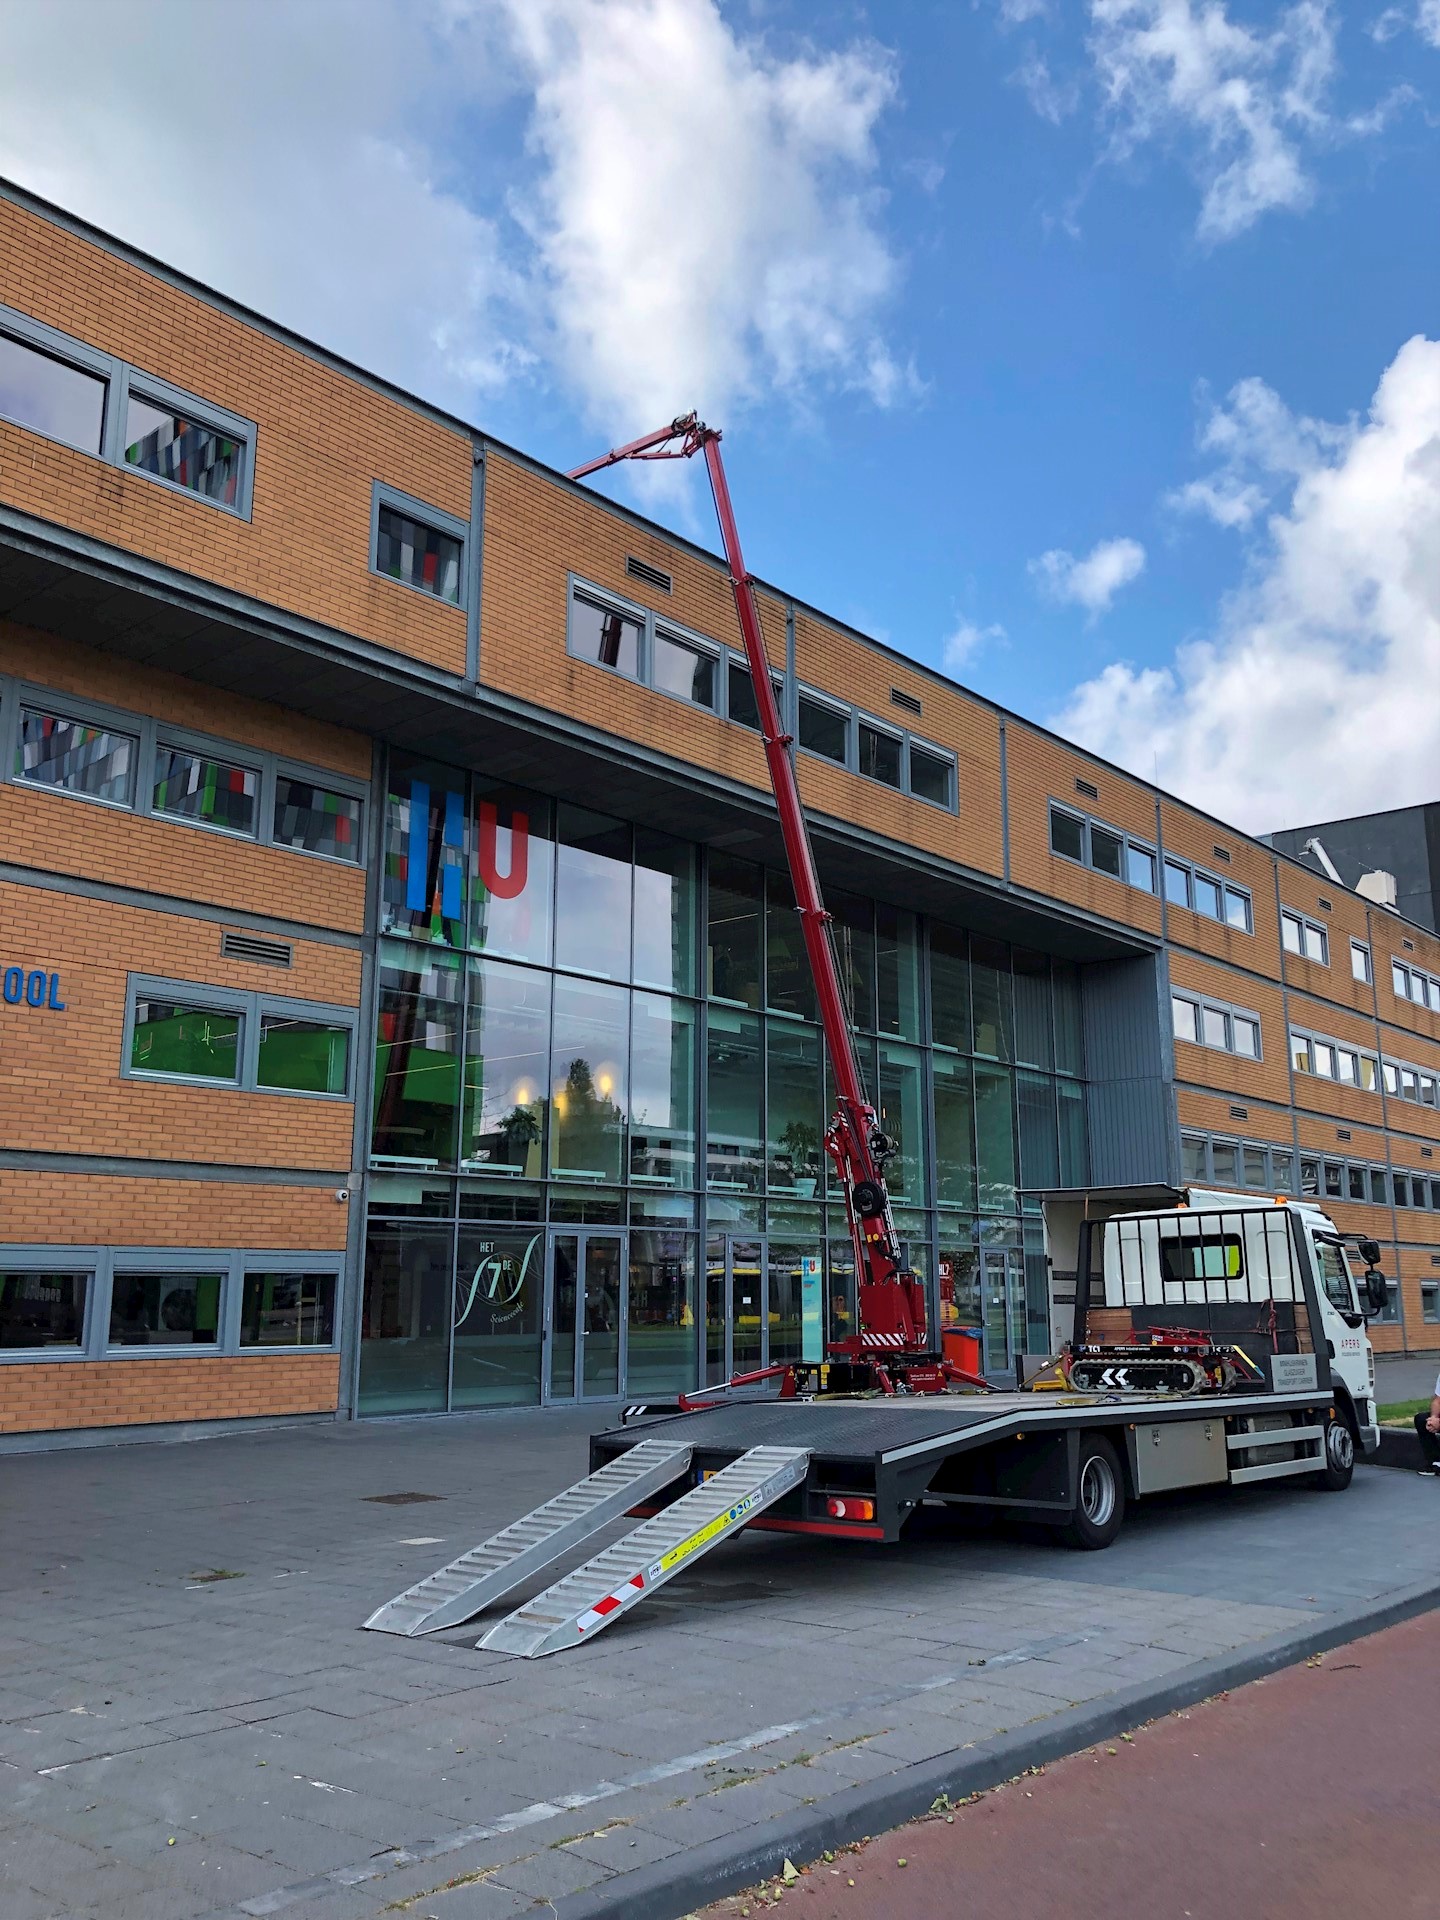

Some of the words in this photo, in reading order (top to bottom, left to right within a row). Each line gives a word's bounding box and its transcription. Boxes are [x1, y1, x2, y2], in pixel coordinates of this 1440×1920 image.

[406, 780, 529, 920] HU
[0, 965, 65, 1010] OOL
[480, 1242, 495, 1253] HET
[488, 1262, 502, 1298] 7
[502, 1260, 512, 1271] DE
[1088, 1345, 1100, 1353] TC1
[1341, 1339, 1361, 1349] APERS
